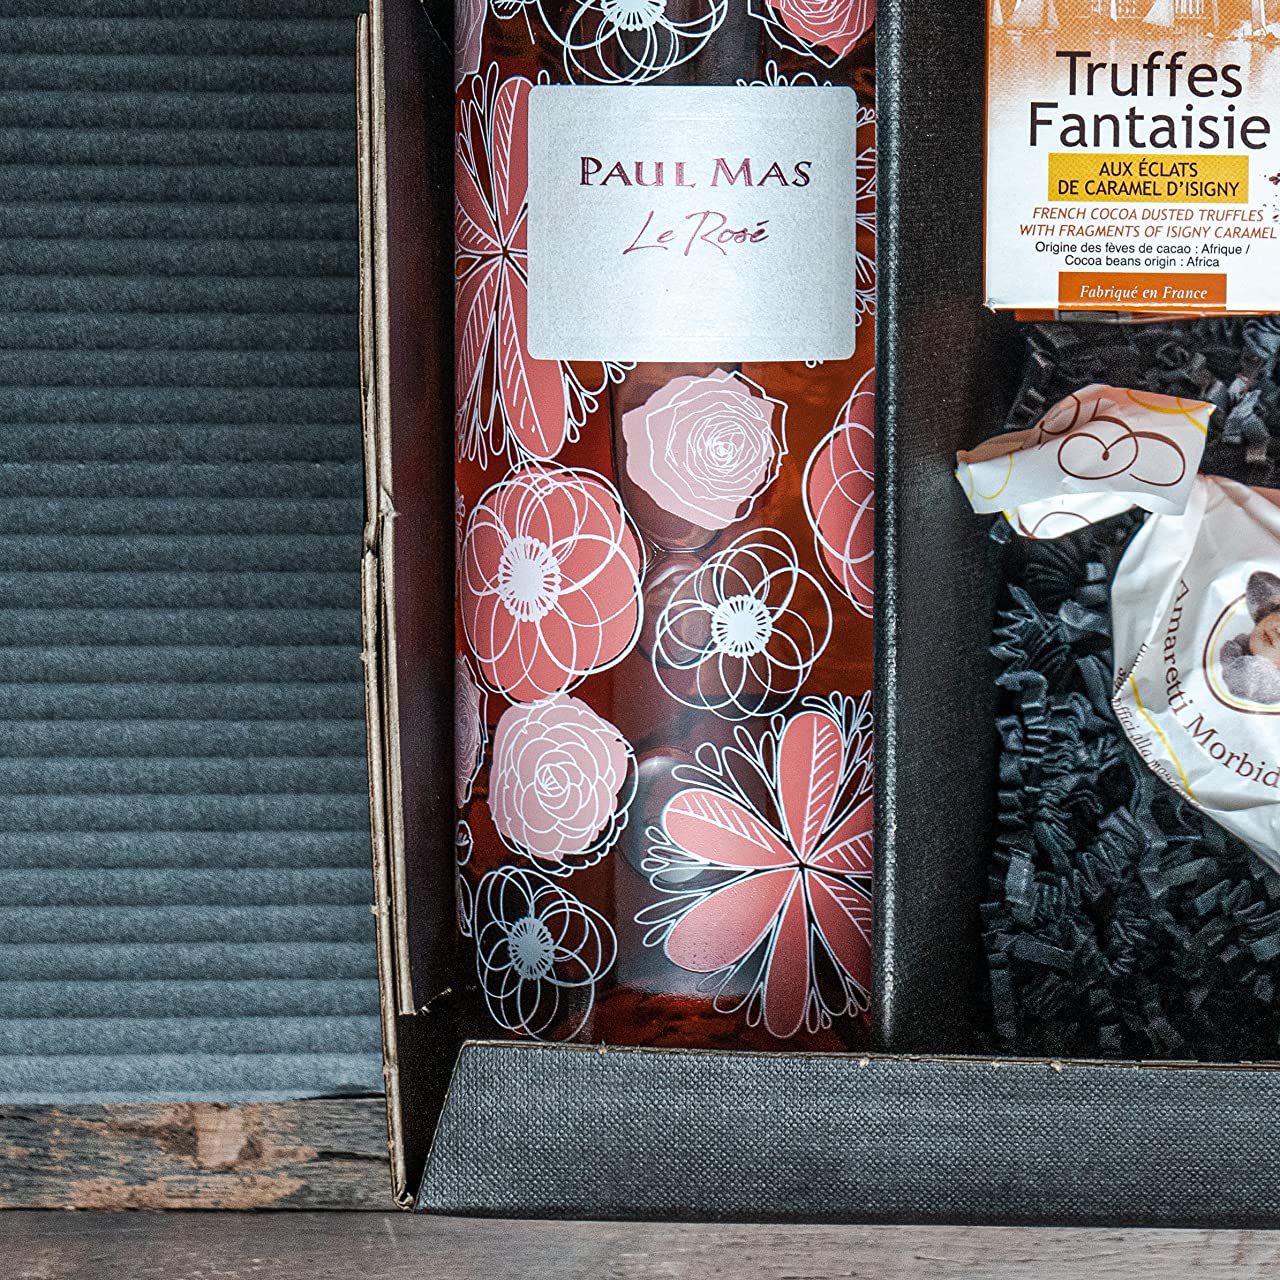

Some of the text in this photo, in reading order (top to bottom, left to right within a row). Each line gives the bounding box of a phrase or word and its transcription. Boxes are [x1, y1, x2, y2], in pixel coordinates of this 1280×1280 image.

[1055, 50, 1243, 98] Truffes
[1029, 101, 1271, 150] Fantaisie
[579, 156, 812, 188] PAUL MAS
[1099, 158, 1199, 178] AUX ÉCLATS
[1057, 179, 1078, 196] DE
[1084, 180, 1163, 197] CARAMEL
[1032, 207, 1264, 222] FRENCH COCOA DUSTED TRUFFLES
[622, 210, 770, 256] Le Rosé
[1020, 224, 1278, 239] WITH FRAGMENTS OF ISIGNY CARAMEL
[1035, 241, 1077, 256] Origine
[1080, 242, 1101, 254] des
[1105, 242, 1136, 254] fèves
[1138, 243, 1153, 254] de
[1156, 246, 1191, 255] cacao
[1201, 243, 1242, 257] Afrique
[1064, 255, 1102, 267] Cocoa
[1106, 256, 1141, 267] beans
[1144, 256, 1177, 270] origin
[1186, 257, 1220, 268] Africa
[1079, 285, 1209, 302] Fabriqué en France
[1163, 579, 1194, 716] Amaretti
[1130, 733, 1153, 757] alla
